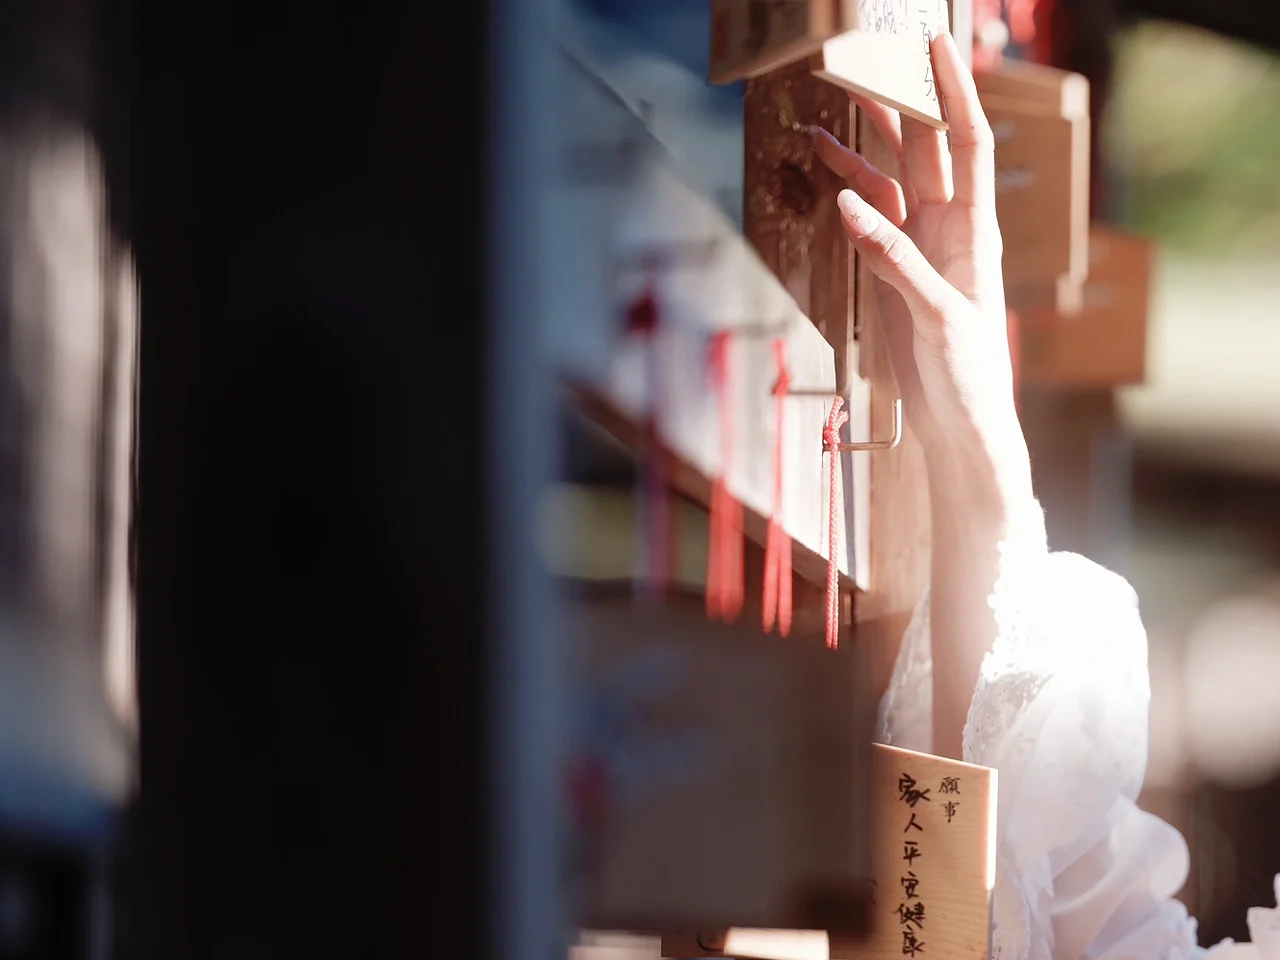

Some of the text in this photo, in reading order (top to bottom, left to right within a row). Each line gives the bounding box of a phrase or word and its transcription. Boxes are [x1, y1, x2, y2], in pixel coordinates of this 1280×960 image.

[938, 776, 961, 823] 願事
[893, 772, 931, 958] 家人平安健康
